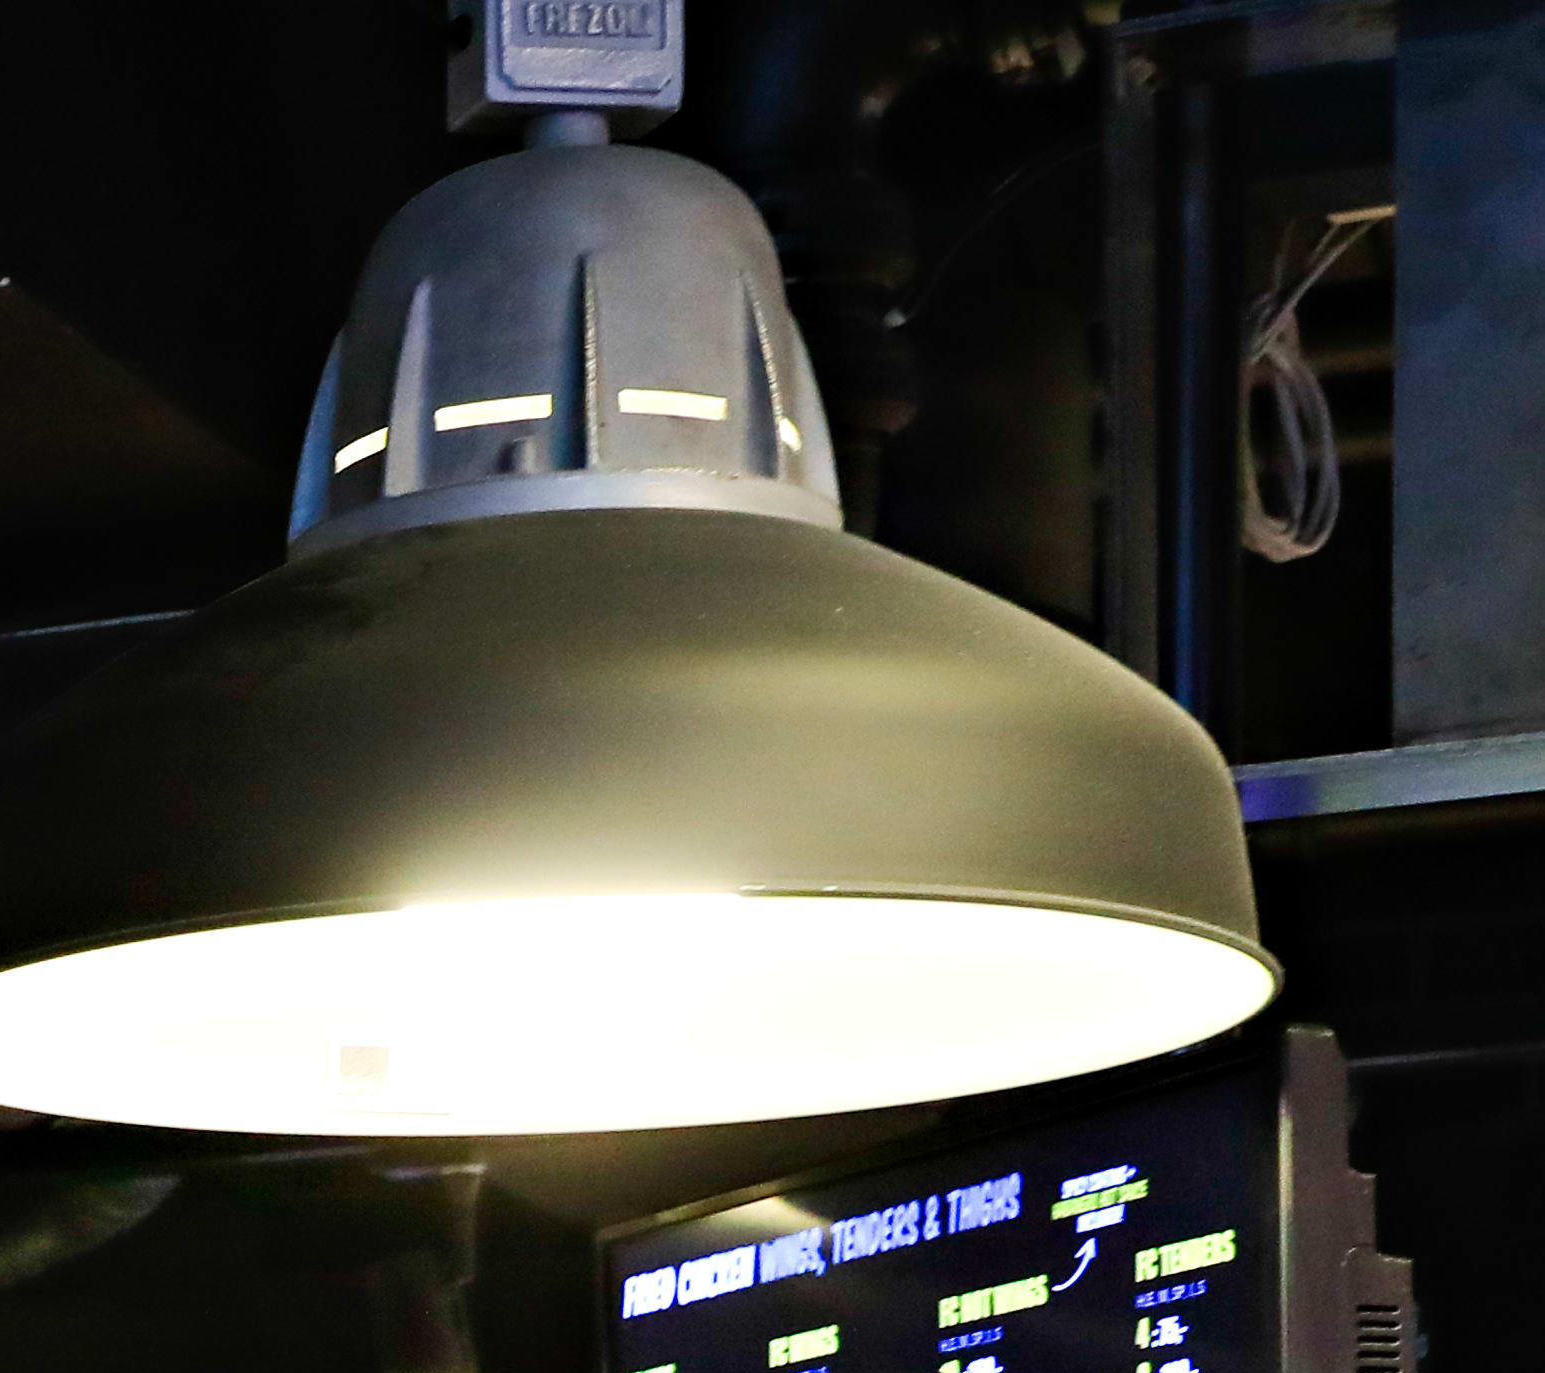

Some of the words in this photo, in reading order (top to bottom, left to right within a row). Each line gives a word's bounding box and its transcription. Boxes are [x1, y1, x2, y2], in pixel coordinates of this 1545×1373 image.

[623, 1265, 676, 1319] FRIED
[678, 1244, 756, 1306] CHICKEN
[830, 1198, 920, 1265] TENDERS
[923, 1194, 941, 1241] &
[947, 1172, 1022, 1234] THIGHS
[1159, 1229, 1236, 1276] TENDERS
